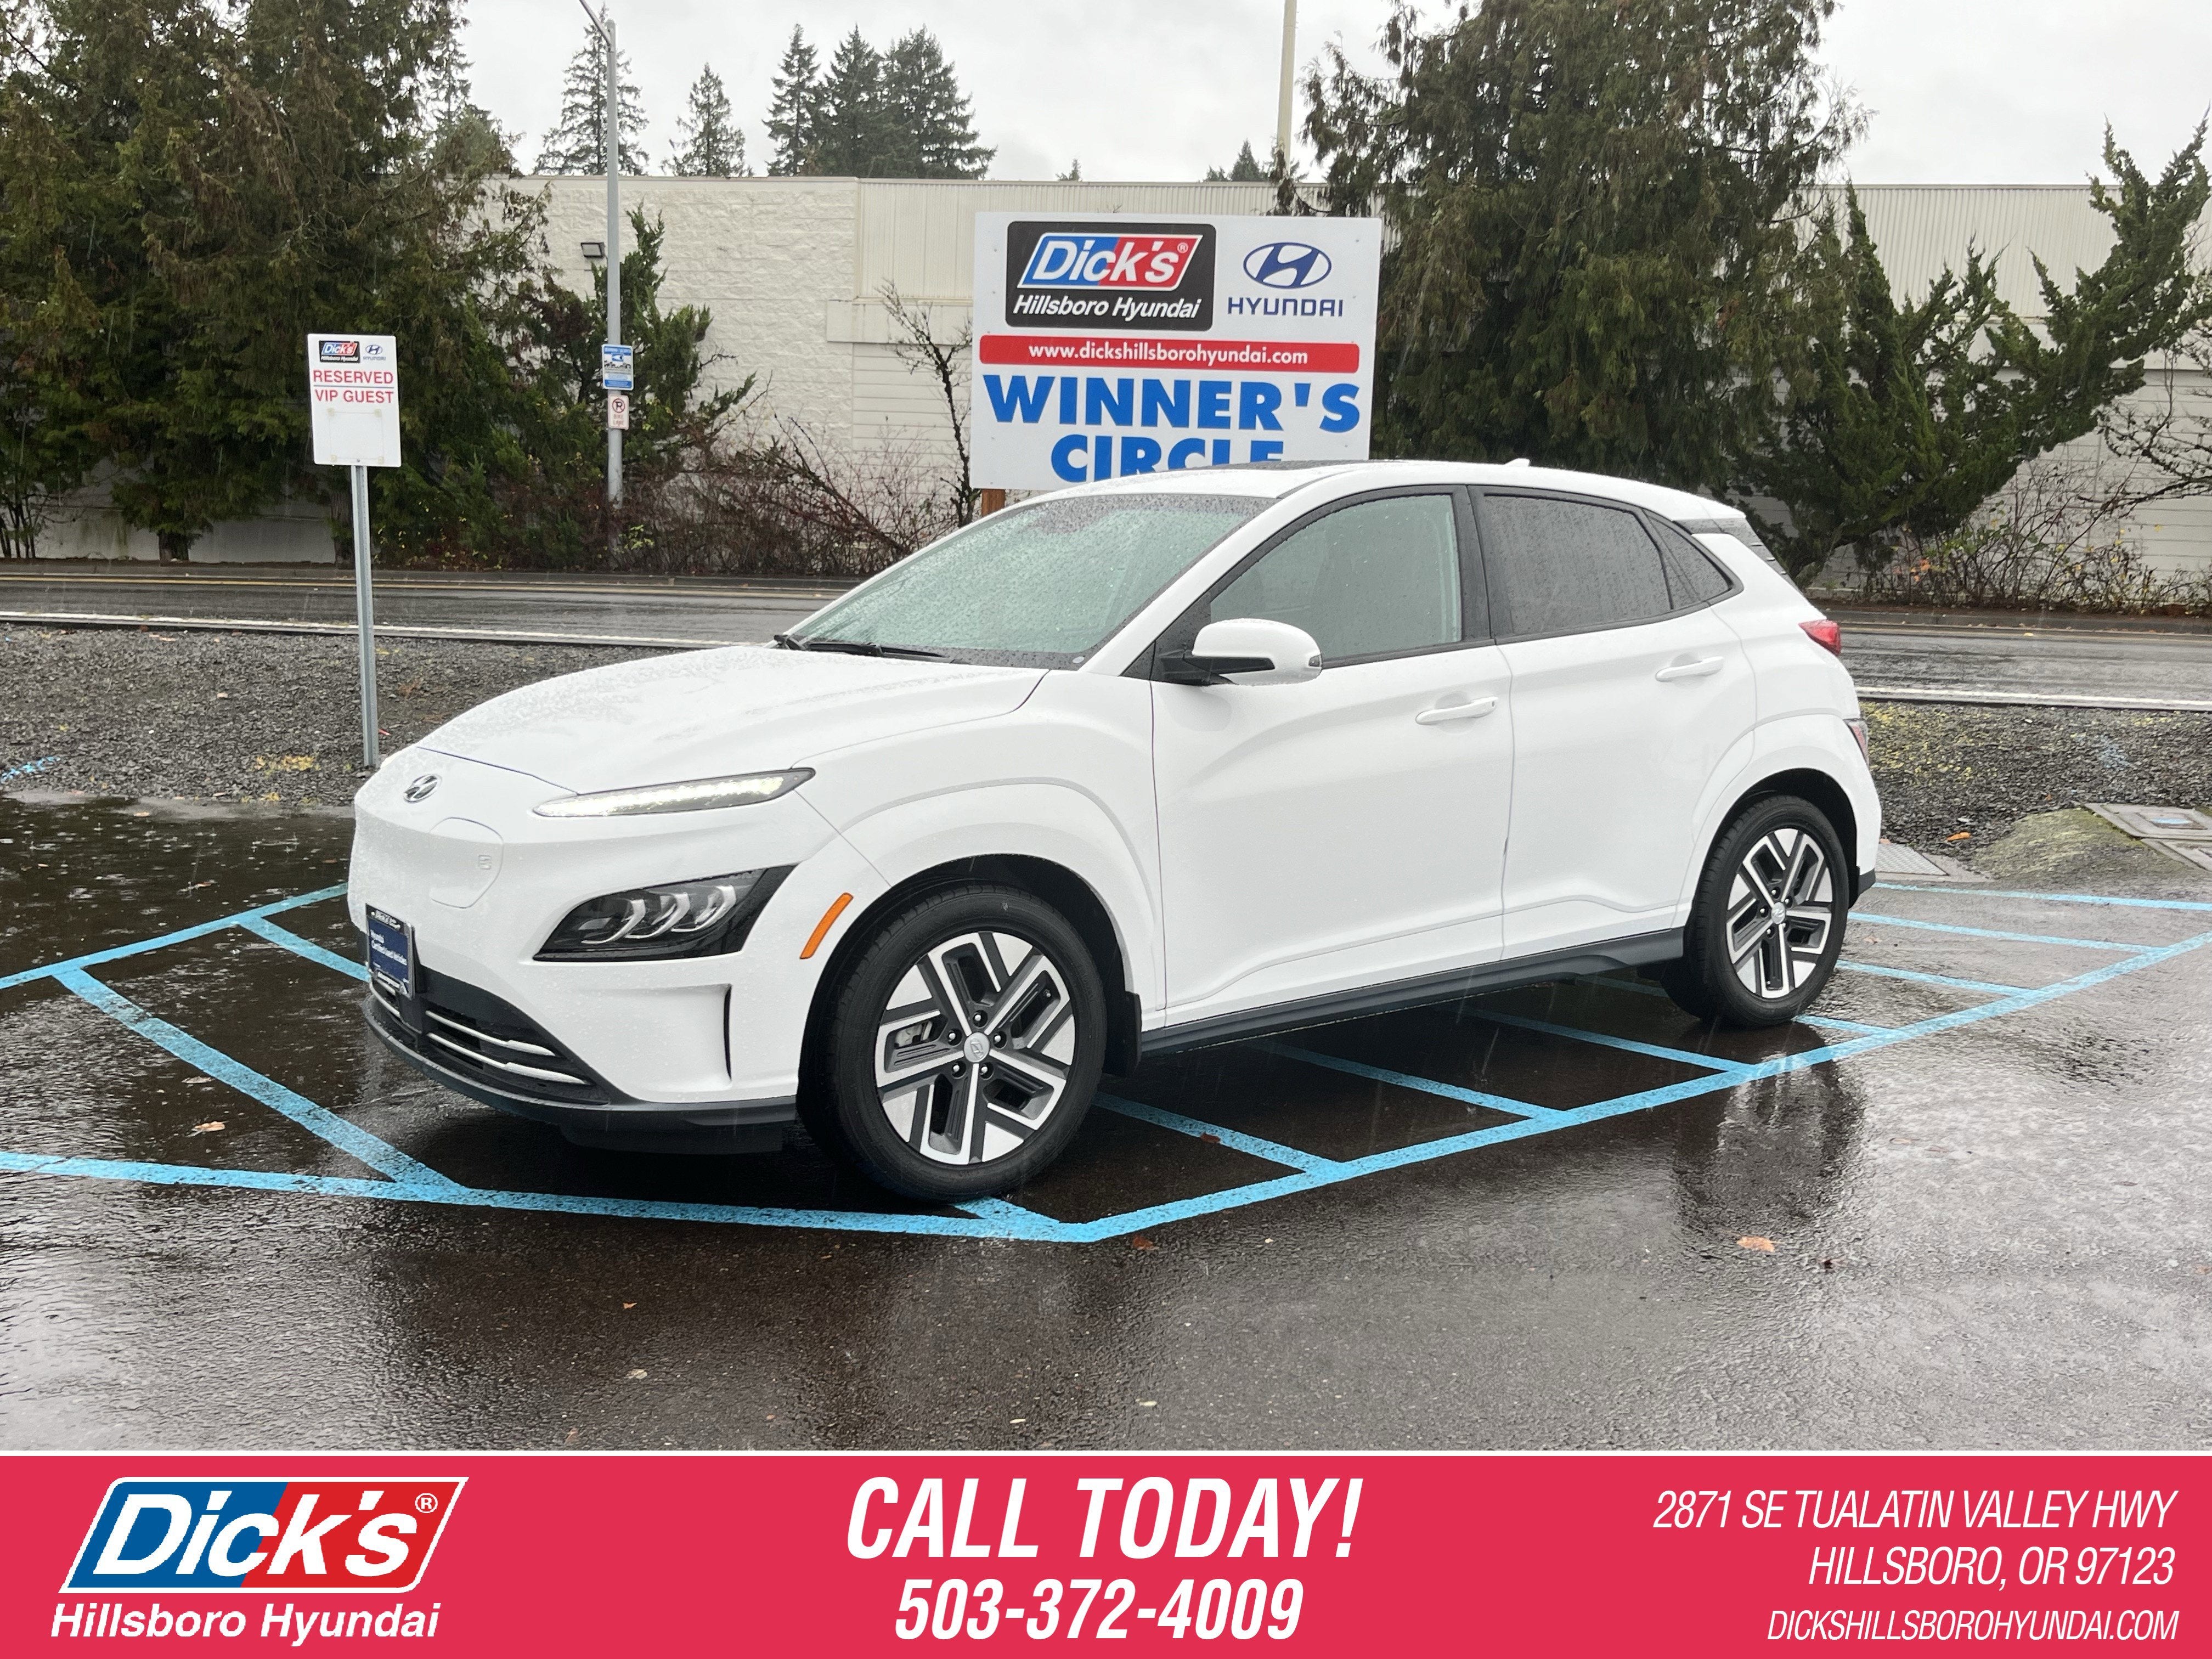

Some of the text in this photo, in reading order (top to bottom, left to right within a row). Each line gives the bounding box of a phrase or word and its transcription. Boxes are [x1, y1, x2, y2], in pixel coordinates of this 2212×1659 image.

[1032, 240, 1179, 283] Dick's
[1013, 294, 1203, 322] Hillsboro Hyundai
[1227, 297, 1343, 317] HYUNDAI
[1029, 342, 1308, 366] www.dickshillsborohyundai.com
[313, 370, 394, 384] RESERVED
[315, 389, 394, 404] VIP GUEST
[983, 375, 1360, 433] WINNER'S
